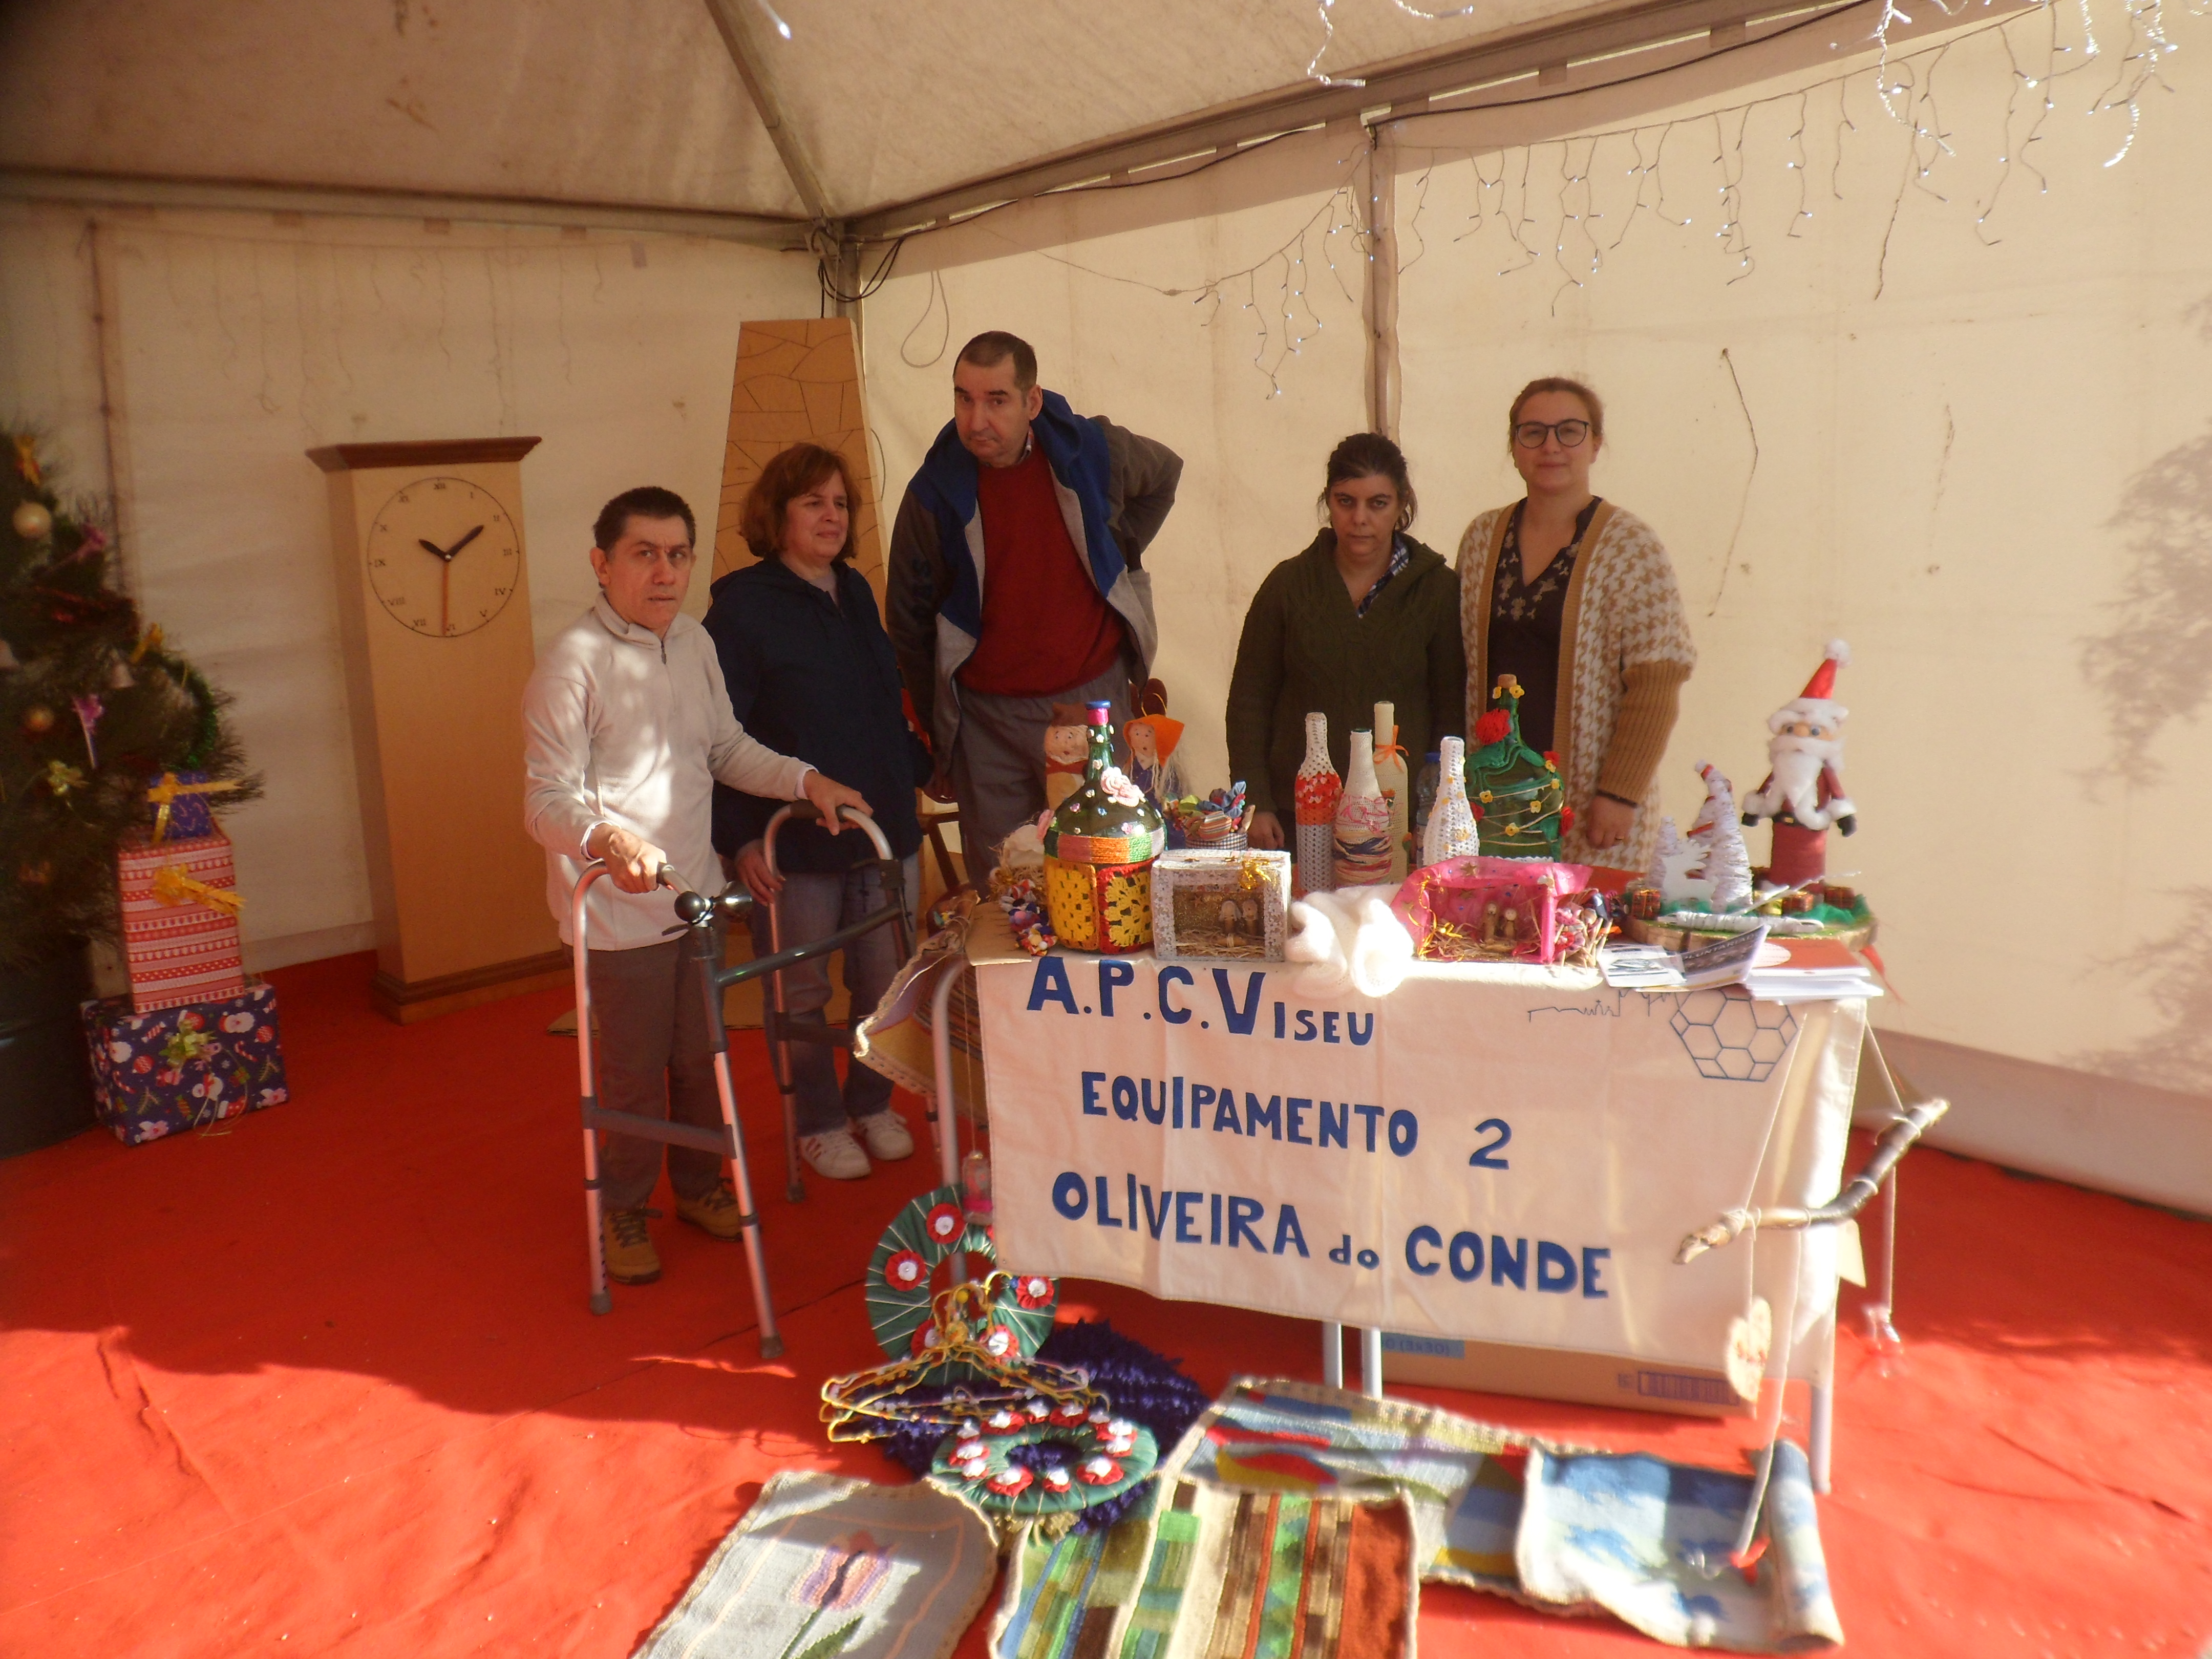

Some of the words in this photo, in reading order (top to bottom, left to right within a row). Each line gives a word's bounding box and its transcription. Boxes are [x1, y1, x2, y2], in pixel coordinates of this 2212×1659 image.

[1081, 1071, 1418, 1157] EQUIPAMENTO
[1469, 1118, 1512, 1169] 2
[1052, 1171, 1310, 1258] OLIVEIRA
[1329, 1233, 1380, 1270] do
[1405, 1225, 1611, 1299] CONDE
